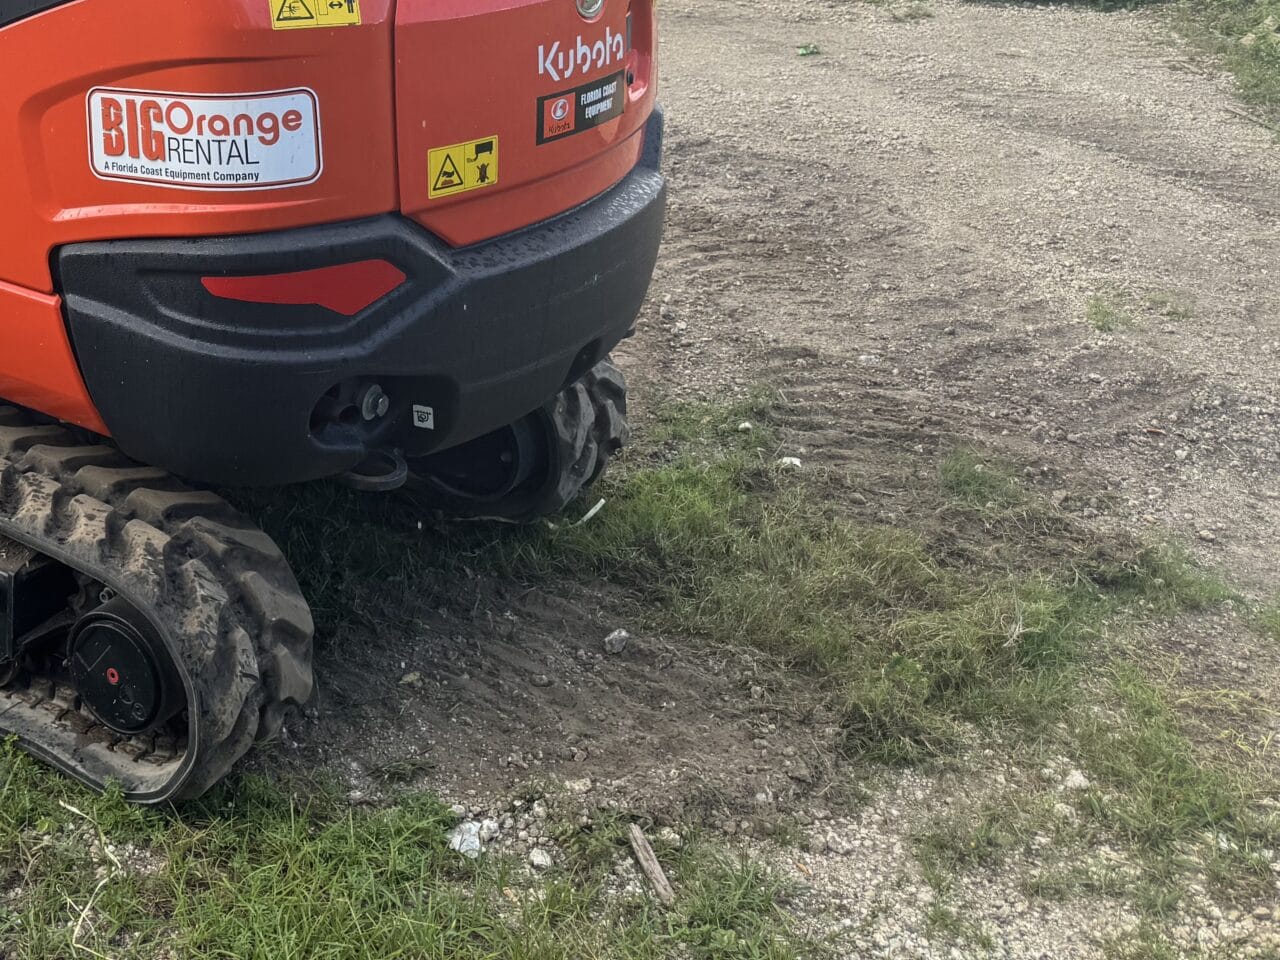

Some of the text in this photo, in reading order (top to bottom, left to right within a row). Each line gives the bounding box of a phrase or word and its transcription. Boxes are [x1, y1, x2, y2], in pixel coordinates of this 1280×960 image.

[538, 26, 624, 82] Kubota
[581, 81, 617, 106] FLORIDA COAST
[585, 97, 613, 119] EQUIPMENT
[100, 96, 303, 163] BIG Orange
[167, 136, 260, 165] RENTAL
[104, 161, 260, 183] A Florida Coast Equipment Company
